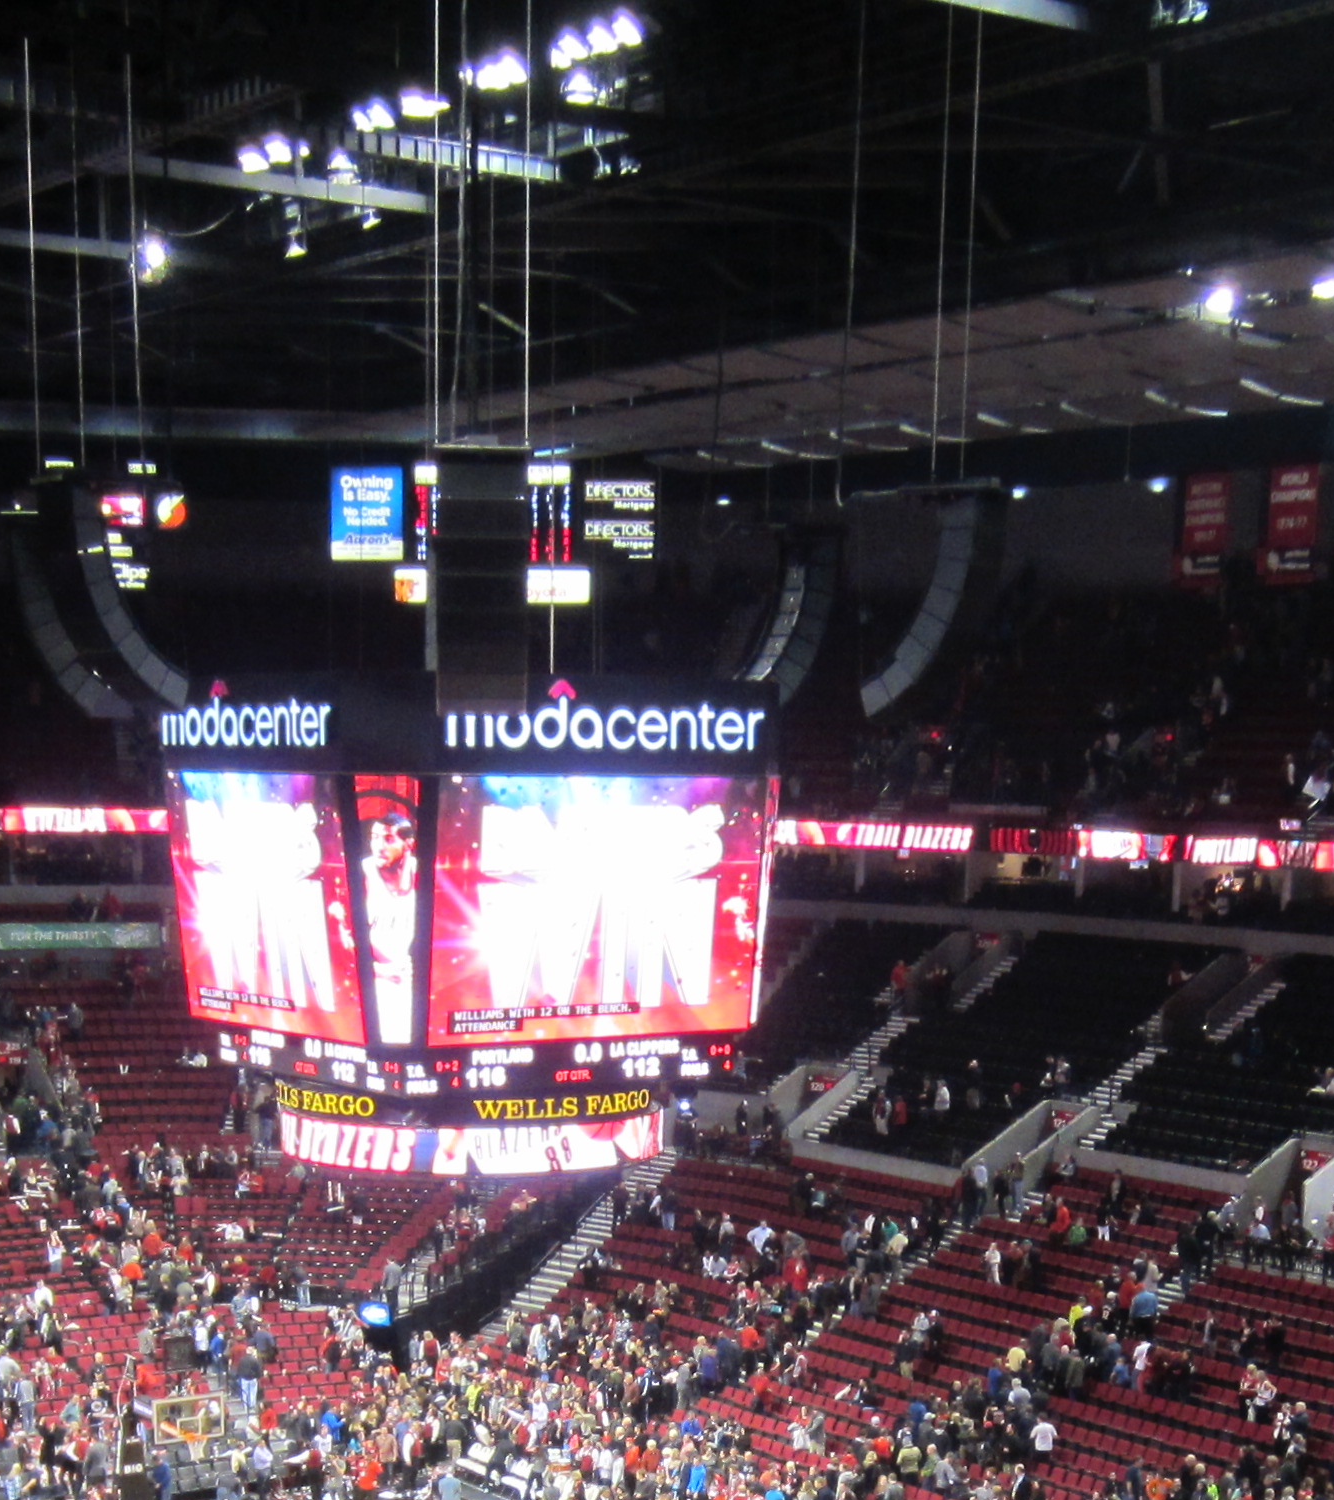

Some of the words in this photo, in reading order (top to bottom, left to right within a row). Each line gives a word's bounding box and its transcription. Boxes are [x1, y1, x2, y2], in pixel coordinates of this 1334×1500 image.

[340, 474, 393, 491] Owning
[360, 488, 391, 504] Easy.
[613, 500, 655, 512] Mortgage
[343, 507, 359, 517] No
[361, 506, 391, 517] Credit
[346, 516, 388, 527] Needed.
[613, 538, 654, 550] Mortgage
[162, 697, 331, 747] modacenter
[855, 823, 900, 848] TRAIL
[903, 825, 973, 850] BLAZERS
[479, 876, 717, 1007] WIN
[454, 1010, 504, 1021] WILLIAMS
[513, 1008, 534, 1019] WITH
[540, 1007, 553, 1018] 12
[558, 1006, 570, 1017] ON
[576, 1005, 593, 1016] THE
[454, 1020, 516, 1032] ATTENDANCE
[471, 1048, 534, 1065] PORTLAND
[574, 1042, 603, 1063] 0.0
[610, 1042, 627, 1057] LA
[628, 1039, 680, 1056] CLIPPERS
[331, 1061, 356, 1083] 112
[451, 1076, 461, 1088] 4
[467, 1066, 506, 1088] 116
[622, 1056, 660, 1078] 112
[723, 1060, 731, 1071] 4
[302, 1089, 375, 1117] FARGO
[473, 1097, 579, 1120] WELLS
[585, 1089, 650, 1115] FARGO
[297, 1118, 415, 1173] BLAZERS
